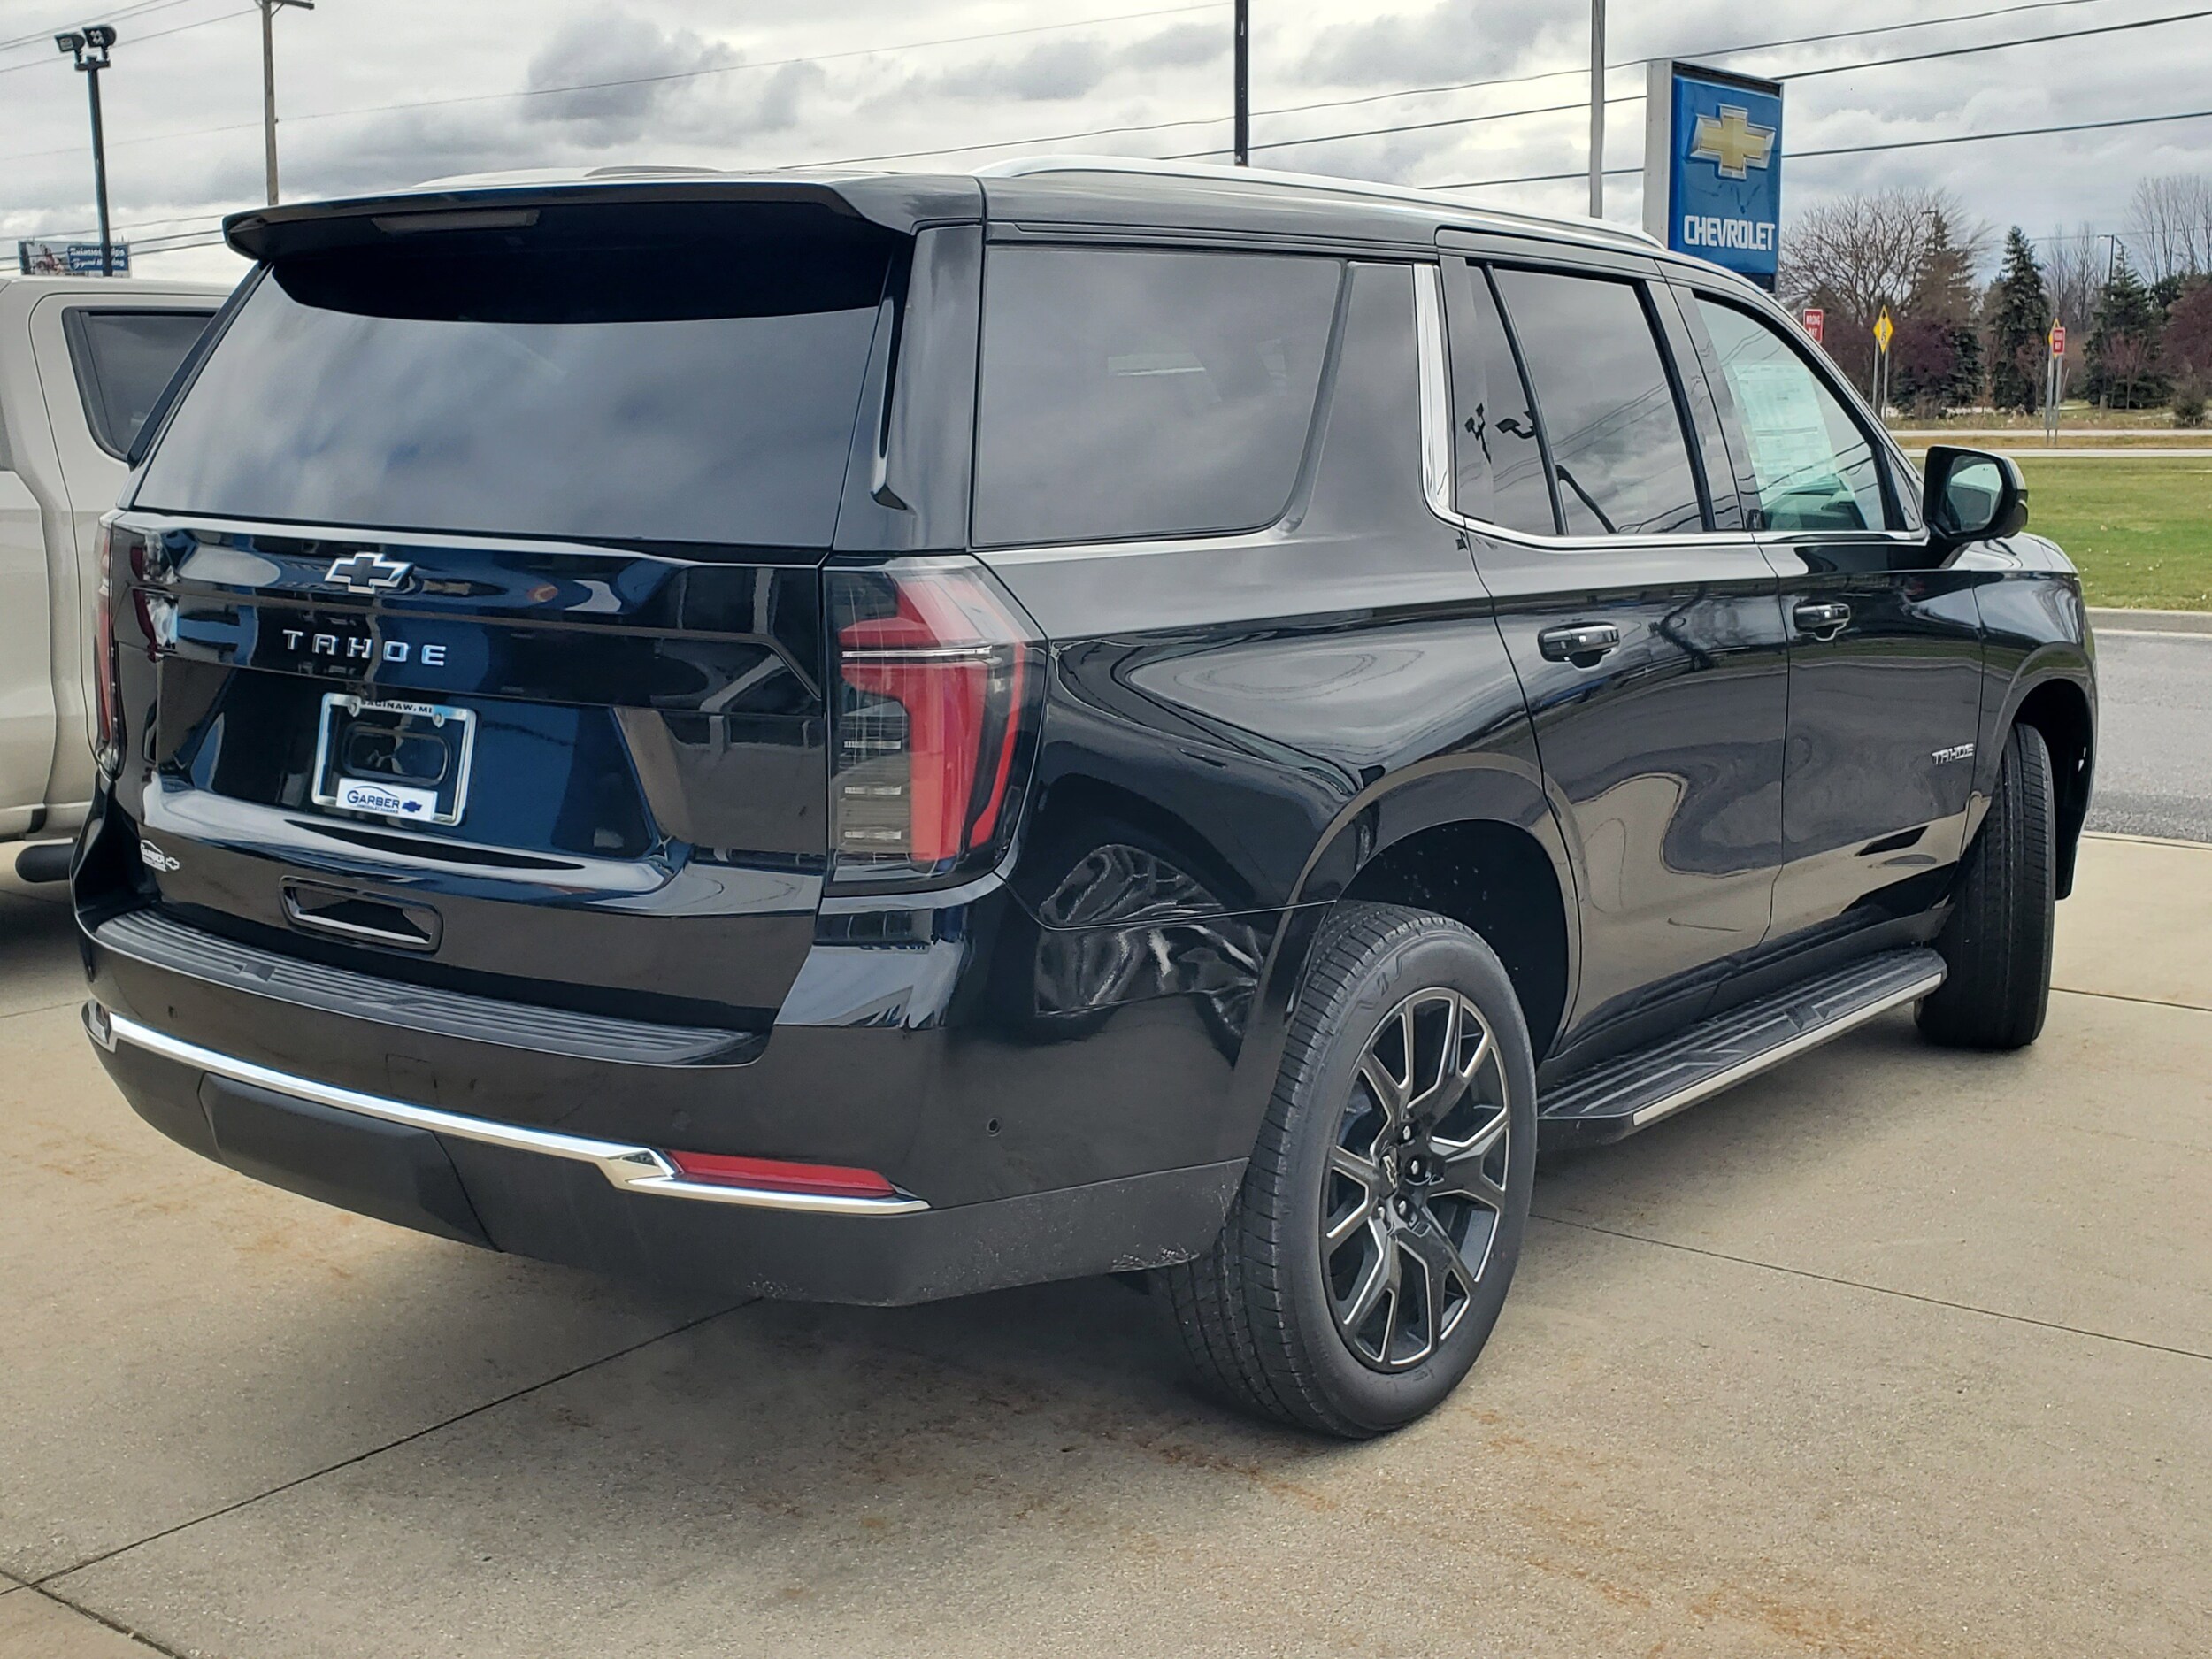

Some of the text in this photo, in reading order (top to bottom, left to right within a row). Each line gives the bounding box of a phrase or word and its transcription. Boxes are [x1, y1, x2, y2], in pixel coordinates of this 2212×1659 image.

[1684, 215, 1775, 250] CHEVROLET
[282, 629, 447, 666] TAHOE
[1932, 743, 1974, 765] TAHOE
[347, 790, 400, 810] GARBER
